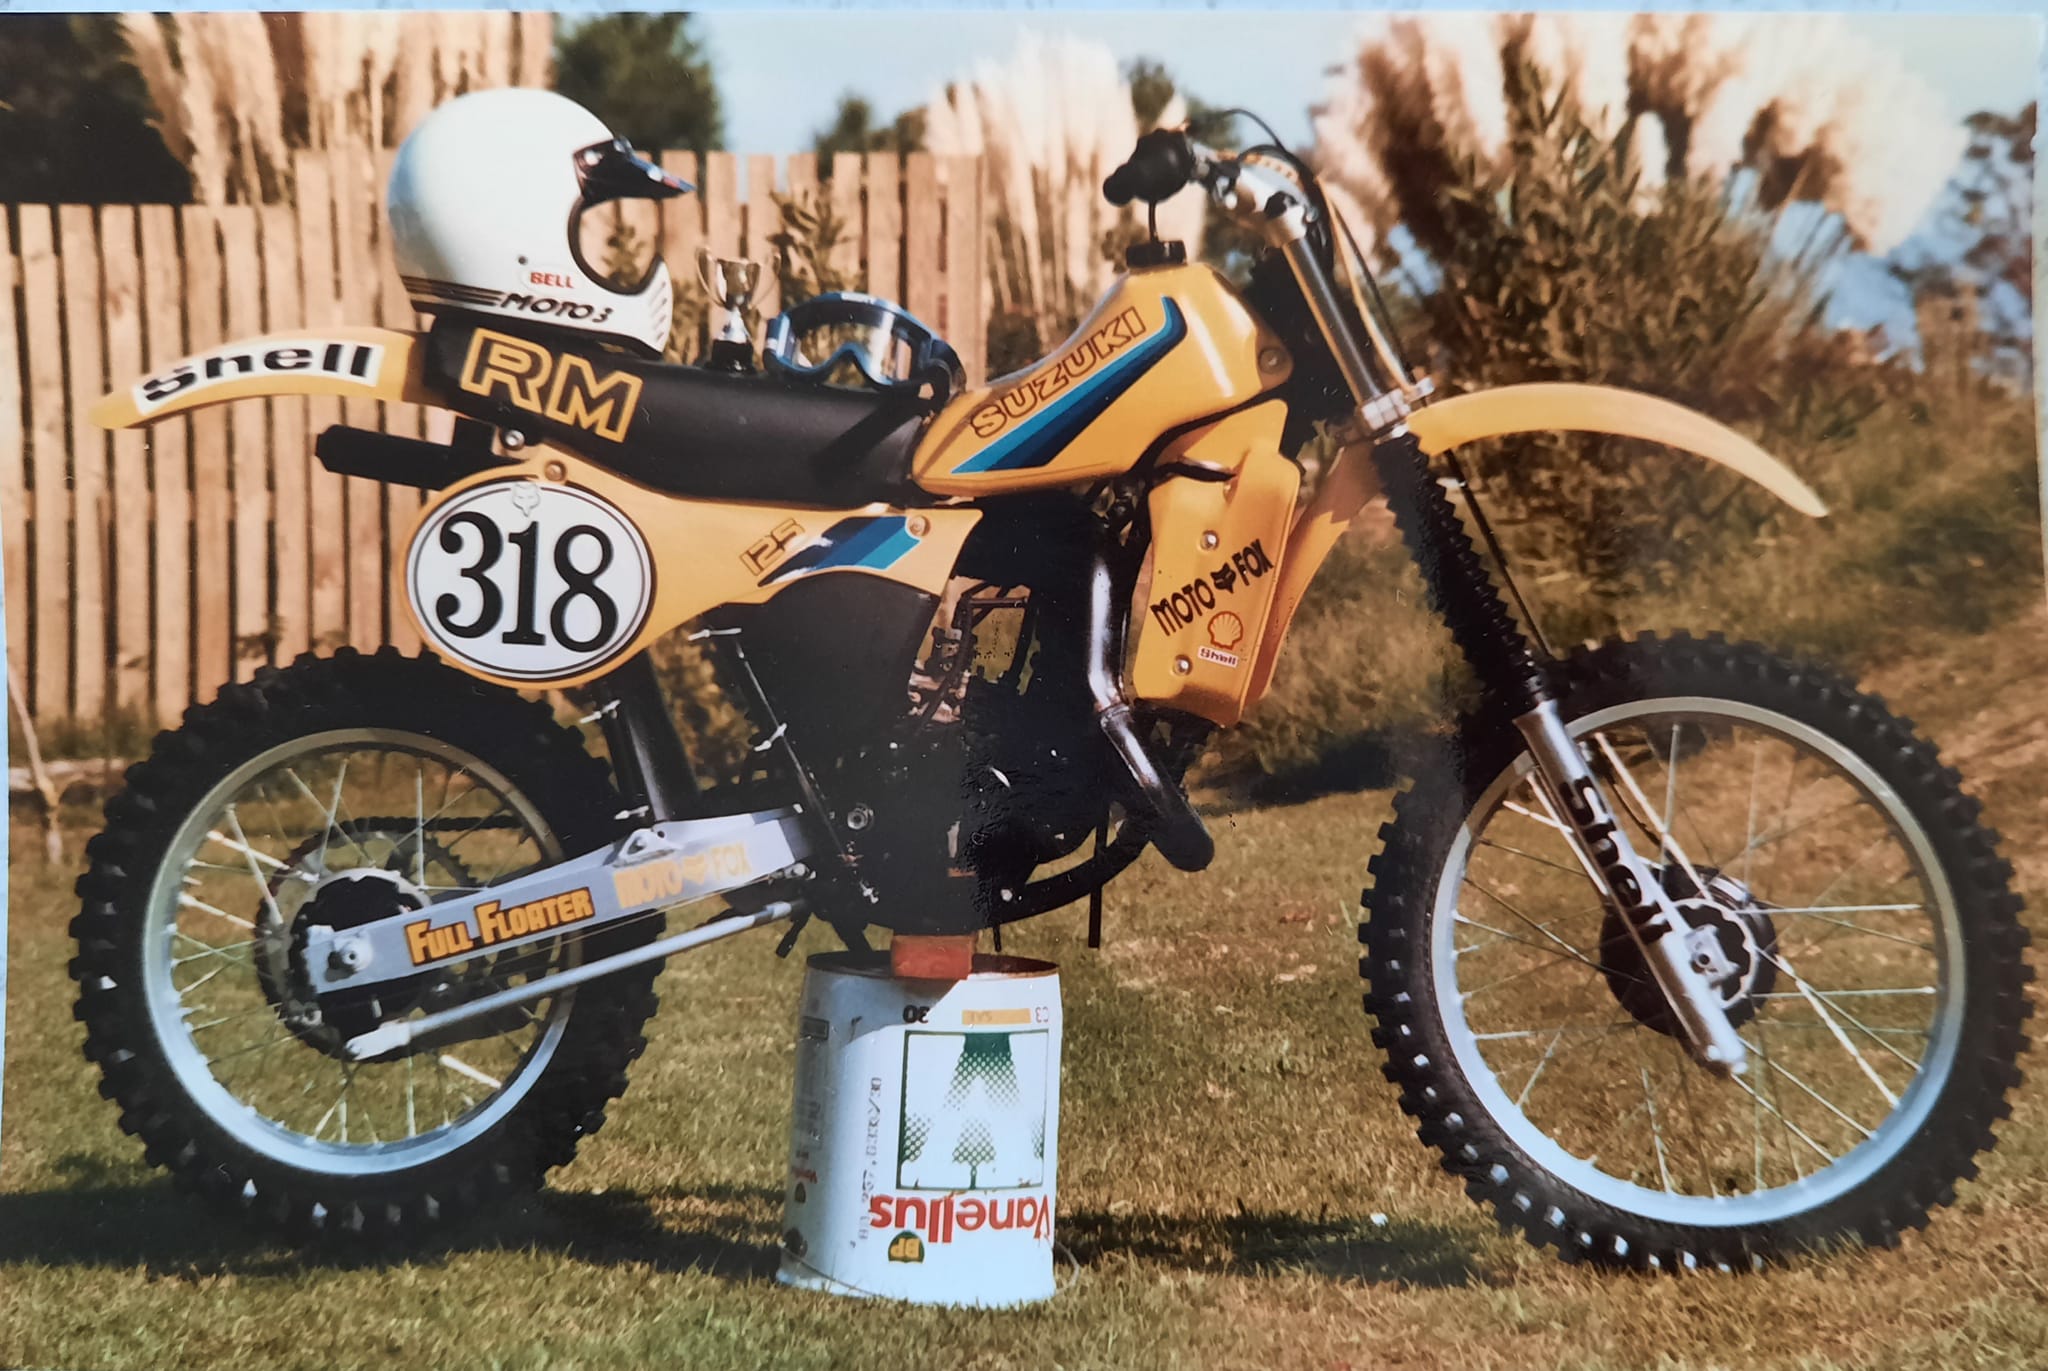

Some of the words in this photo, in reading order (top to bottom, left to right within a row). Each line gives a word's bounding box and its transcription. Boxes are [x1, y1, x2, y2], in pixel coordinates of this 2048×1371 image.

[530, 272, 574, 289] BELL
[142, 342, 373, 403] Shell
[460, 327, 643, 444] RM
[969, 306, 1146, 439] SUZUKI
[434, 510, 620, 653] 318
[739, 517, 806, 577] 125
[1150, 577, 1216, 637] MOTO
[1231, 538, 1275, 587] FOX
[612, 858, 684, 910] MOTO
[709, 840, 753, 881] FOX
[1558, 774, 1676, 944] Shell
[404, 919, 474, 966] FULL
[474, 887, 596, 946] FLOATER
[869, 1193, 1051, 1244] Vanellus
[889, 1236, 921, 1260] BP
